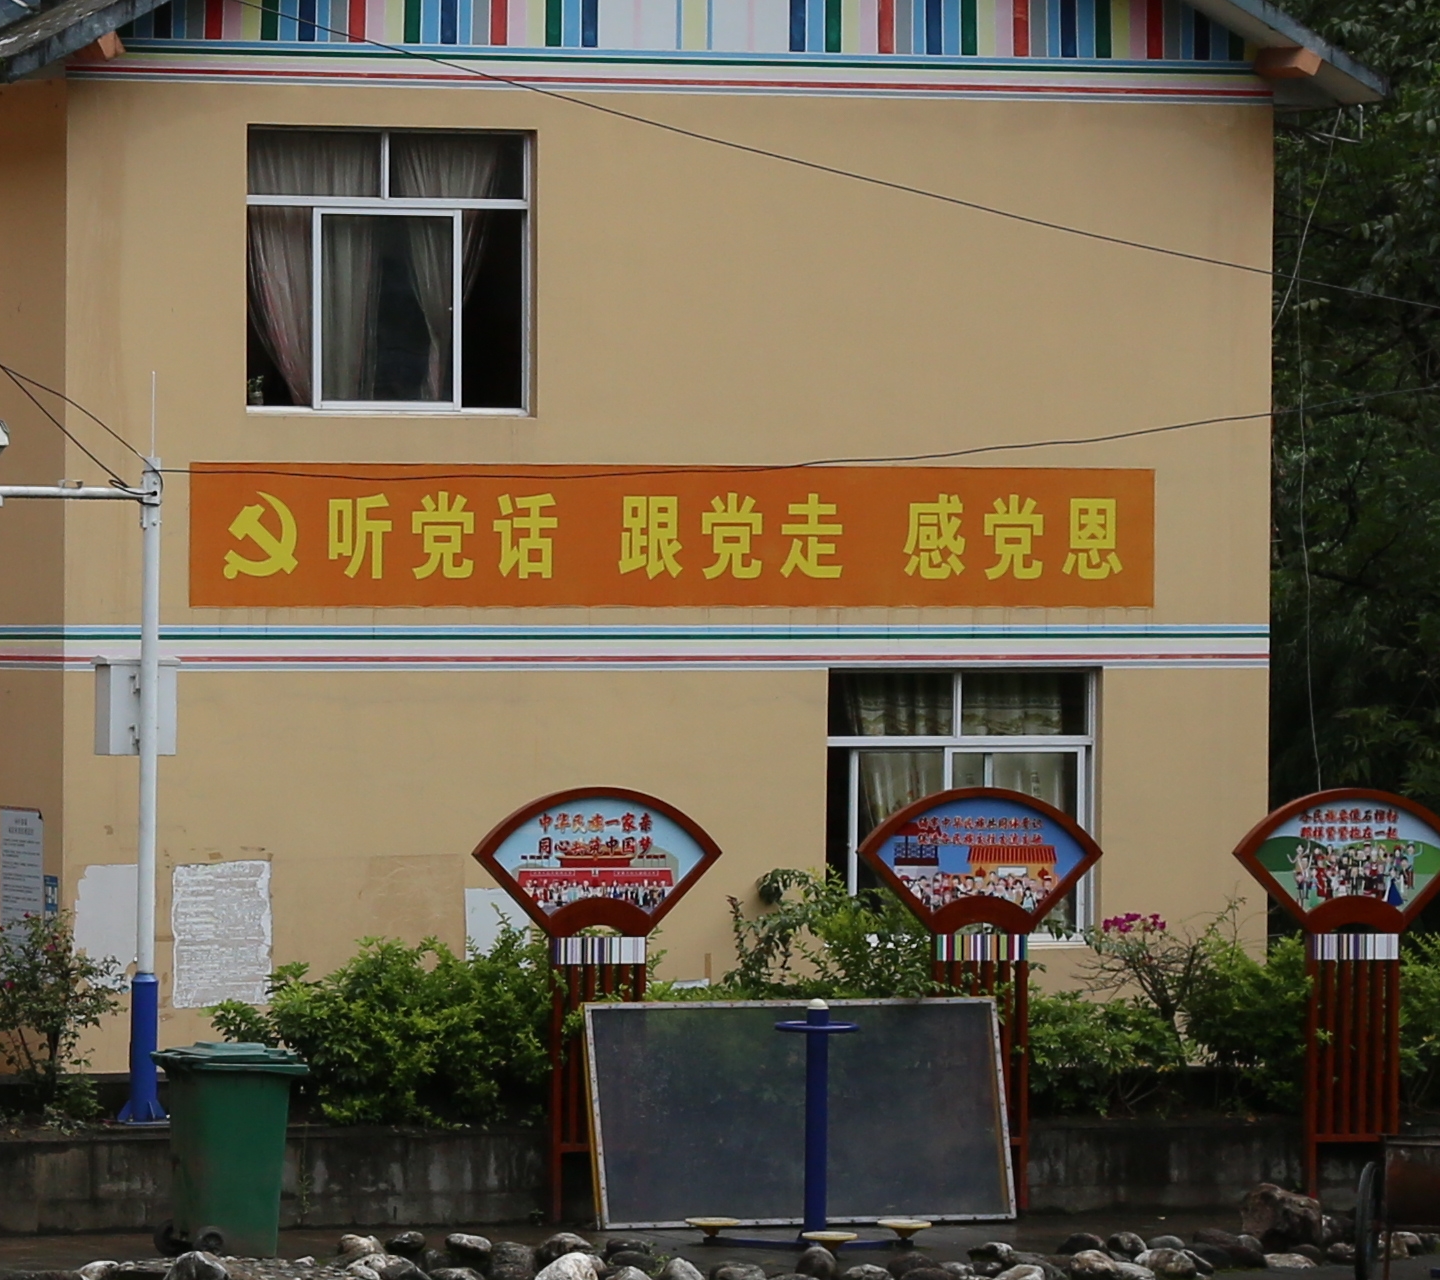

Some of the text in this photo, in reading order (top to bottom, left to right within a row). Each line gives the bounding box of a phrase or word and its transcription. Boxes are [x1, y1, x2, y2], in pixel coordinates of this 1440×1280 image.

[329, 492, 1122, 579] 听党话 跟党走 感党恩
[538, 812, 653, 833] 中华民族一家亲
[538, 836, 654, 855] 同心共筑中国梦
